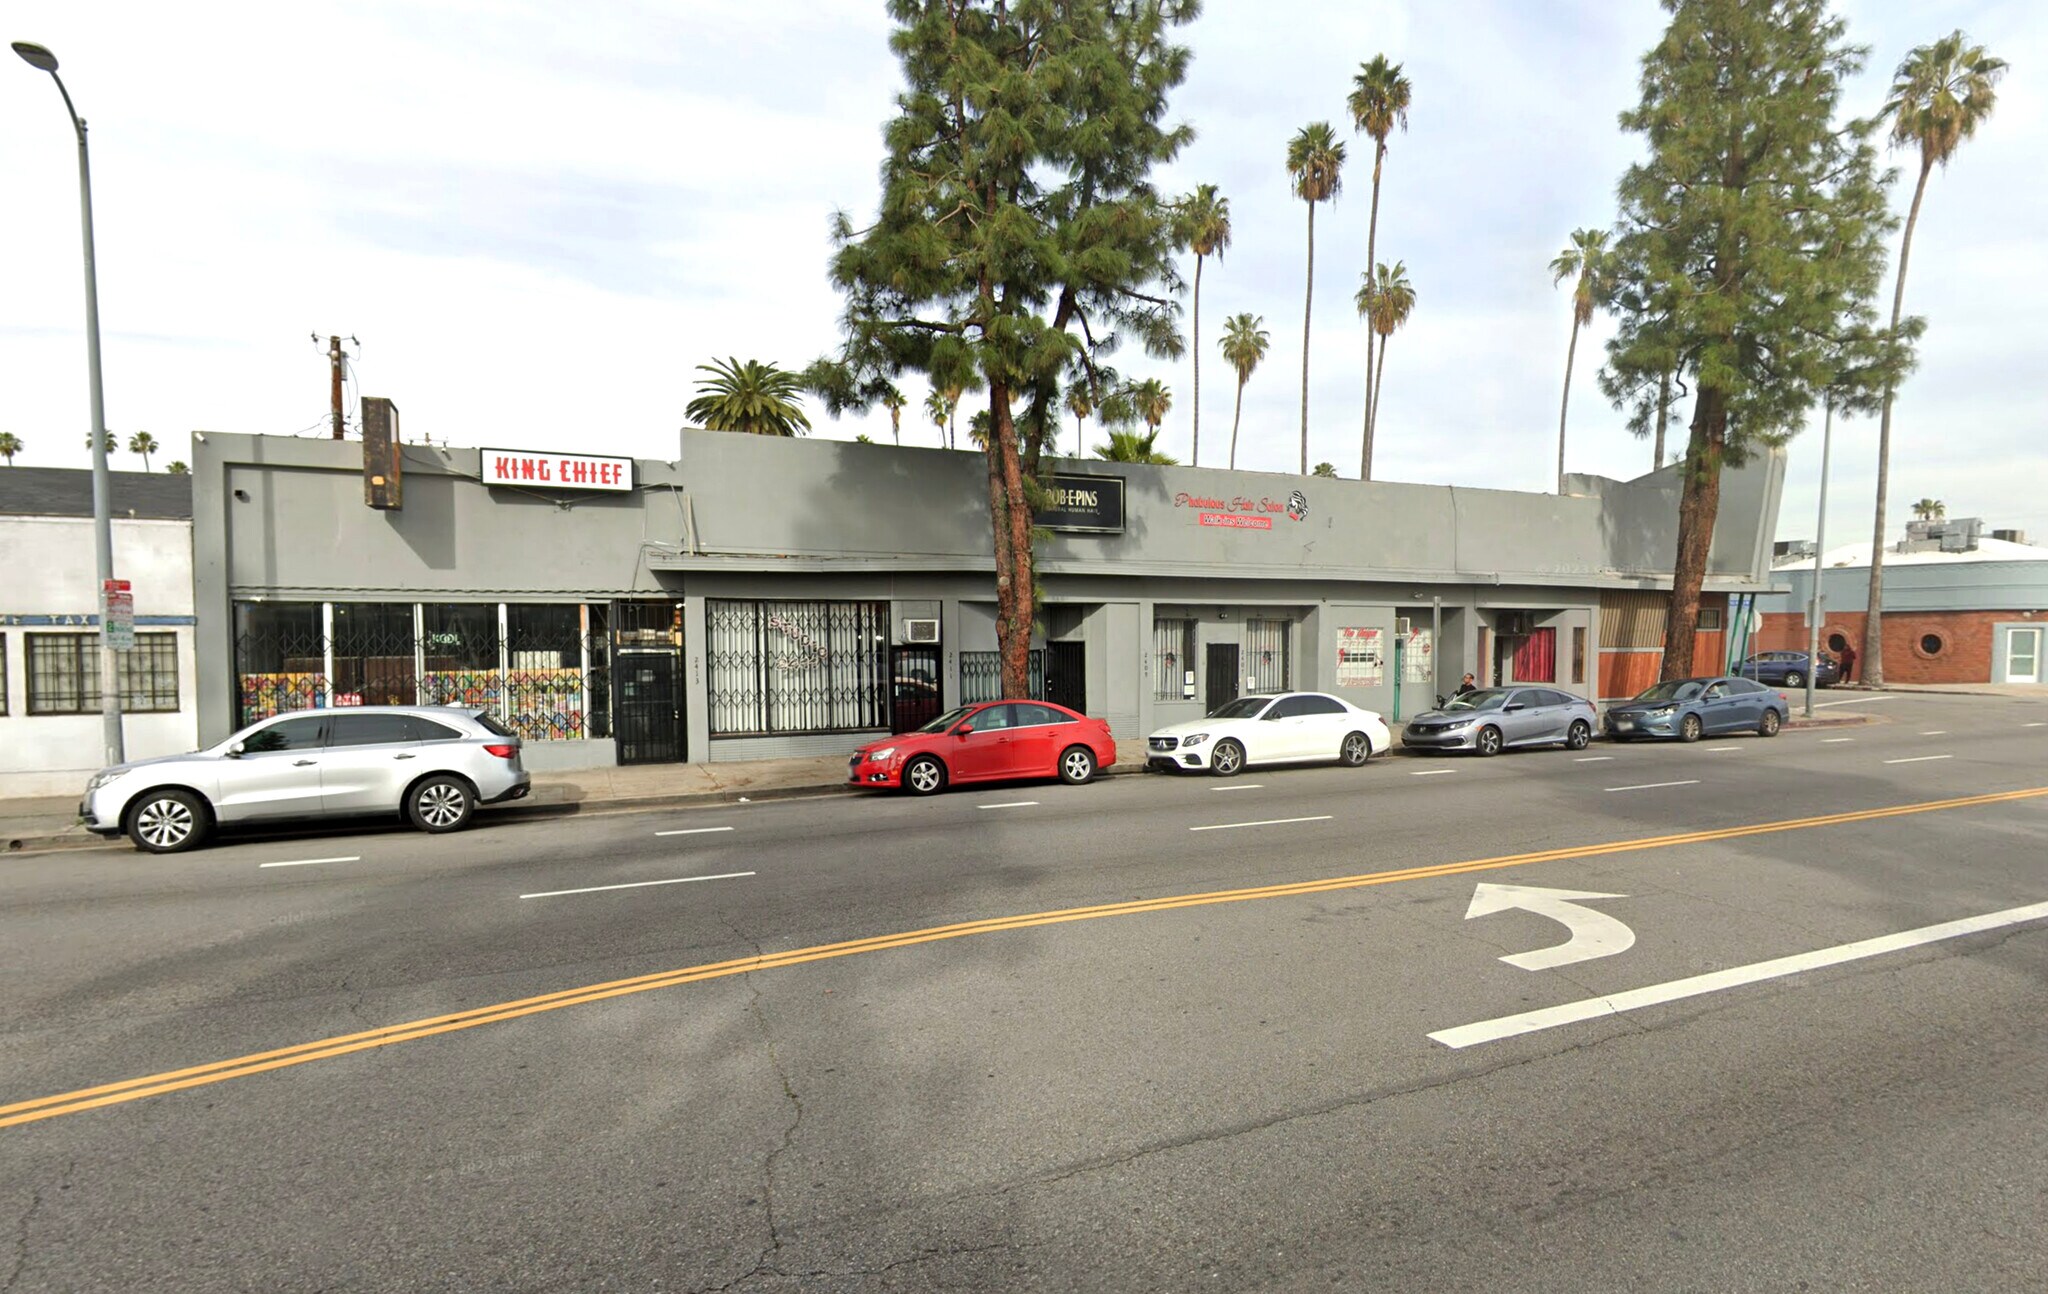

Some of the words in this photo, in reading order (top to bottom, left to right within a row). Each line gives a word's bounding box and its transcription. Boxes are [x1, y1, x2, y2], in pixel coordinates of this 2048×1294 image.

[495, 457, 550, 481] KING
[559, 460, 622, 484] CHIEF
[1174, 493, 1225, 509] Phabulous
[1227, 496, 1254, 512] Hair
[1256, 497, 1284, 513] Salon
[1236, 516, 1268, 528] Welcome
[49, 615, 89, 625] TAX
[769, 617, 827, 658] STUDIO
